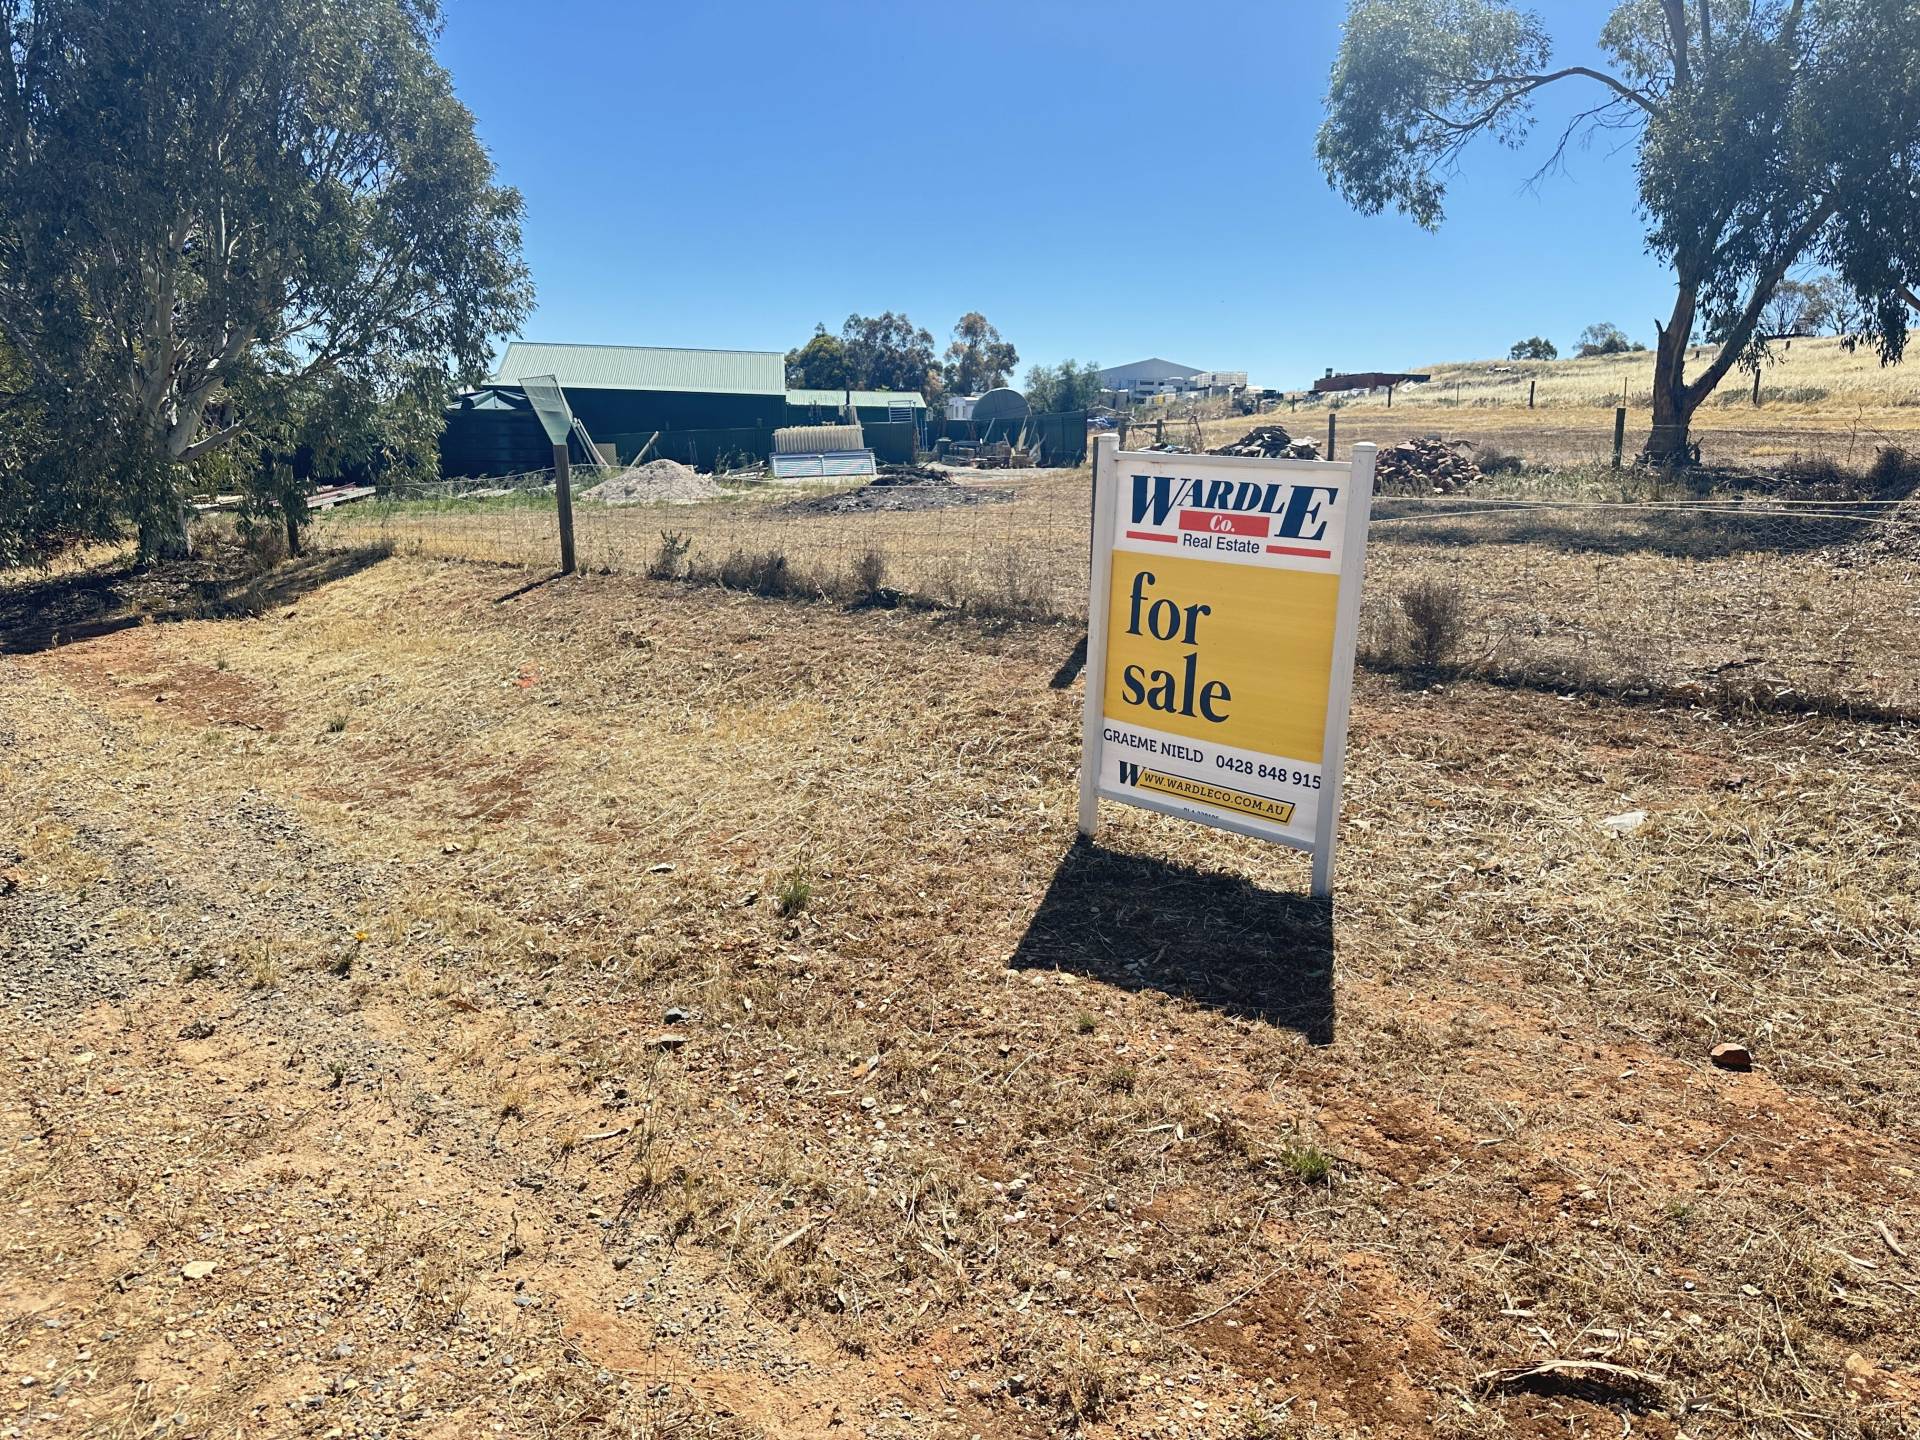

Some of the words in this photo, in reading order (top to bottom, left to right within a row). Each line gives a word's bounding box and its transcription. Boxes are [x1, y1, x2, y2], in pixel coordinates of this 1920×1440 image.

[1130, 474, 1339, 541] WARDLE
[1208, 513, 1236, 533] Co.
[1183, 533, 1212, 549] Real
[1216, 537, 1260, 554] Estate
[1125, 571, 1211, 646] for
[1121, 653, 1232, 723] sale
[1103, 728, 1157, 752] GRAEME
[1160, 742, 1204, 763] NIELD
[1216, 754, 1254, 775] 0428
[1258, 764, 1287, 783] 848
[1292, 771, 1321, 790] 915
